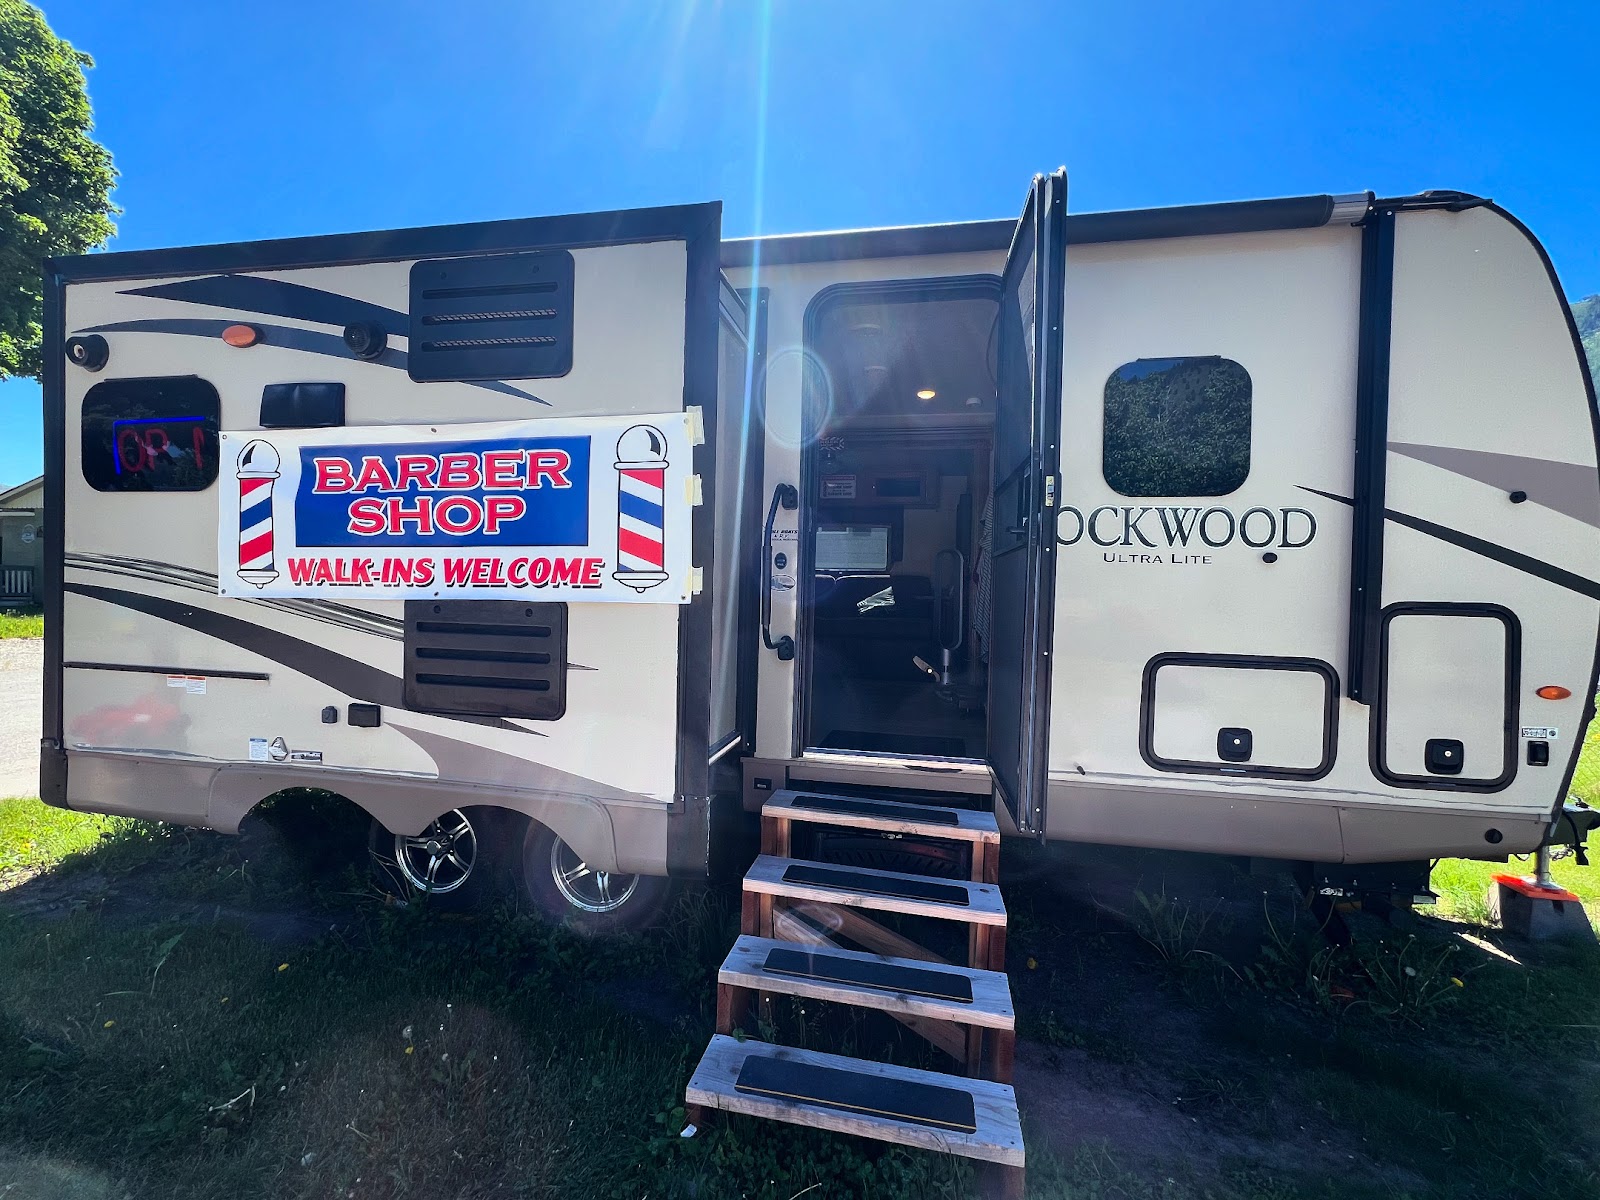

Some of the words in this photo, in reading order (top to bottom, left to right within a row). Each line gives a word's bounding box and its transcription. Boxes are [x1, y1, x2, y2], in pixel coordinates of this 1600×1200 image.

[313, 449, 572, 494] BARBER
[347, 495, 527, 537] SHOP
[1057, 505, 1317, 548] OCKWOOD
[287, 557, 436, 588] WALK-INS
[443, 557, 605, 589] WELCOME
[1103, 552, 1163, 565] ULTRA
[1171, 553, 1213, 565] LITE
